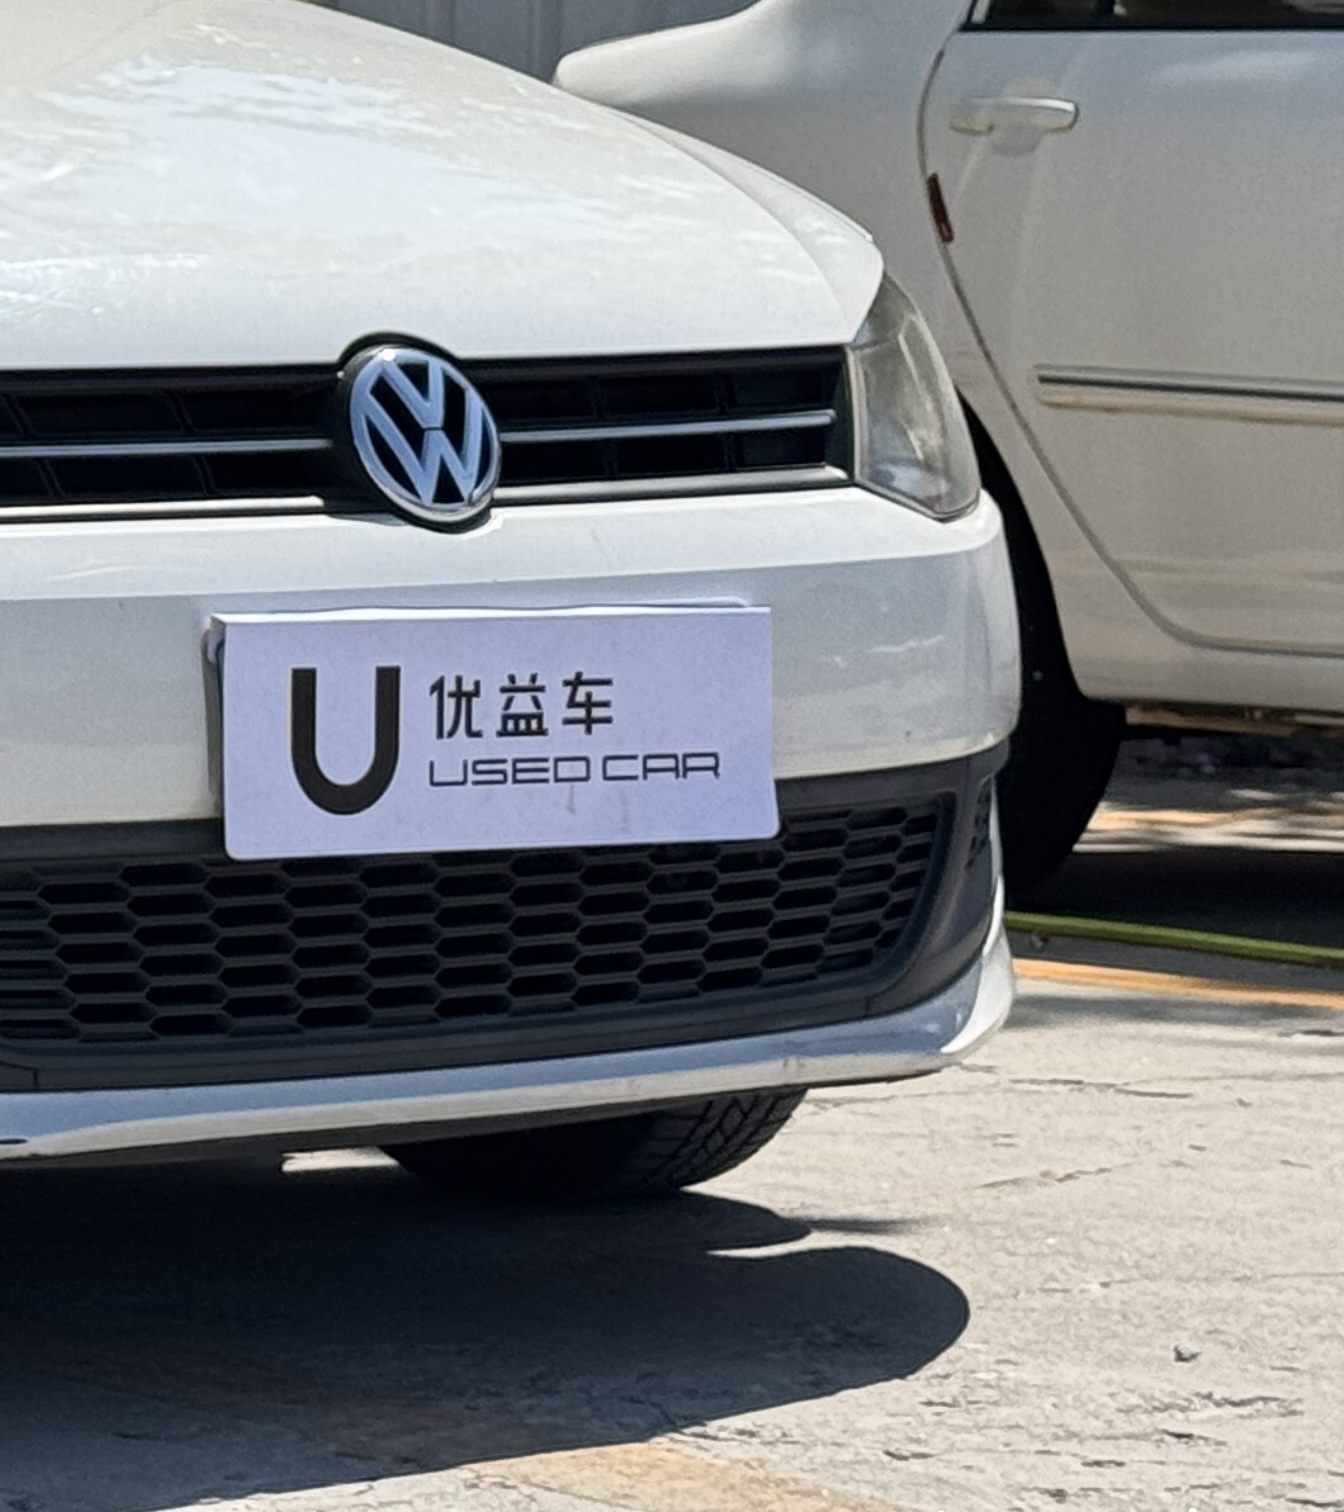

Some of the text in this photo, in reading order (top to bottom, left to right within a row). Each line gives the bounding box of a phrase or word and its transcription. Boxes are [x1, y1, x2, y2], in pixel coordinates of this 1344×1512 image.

[429, 671, 614, 740] 优益车
[290, 665, 402, 816] U
[428, 752, 721, 788] USED CAR
